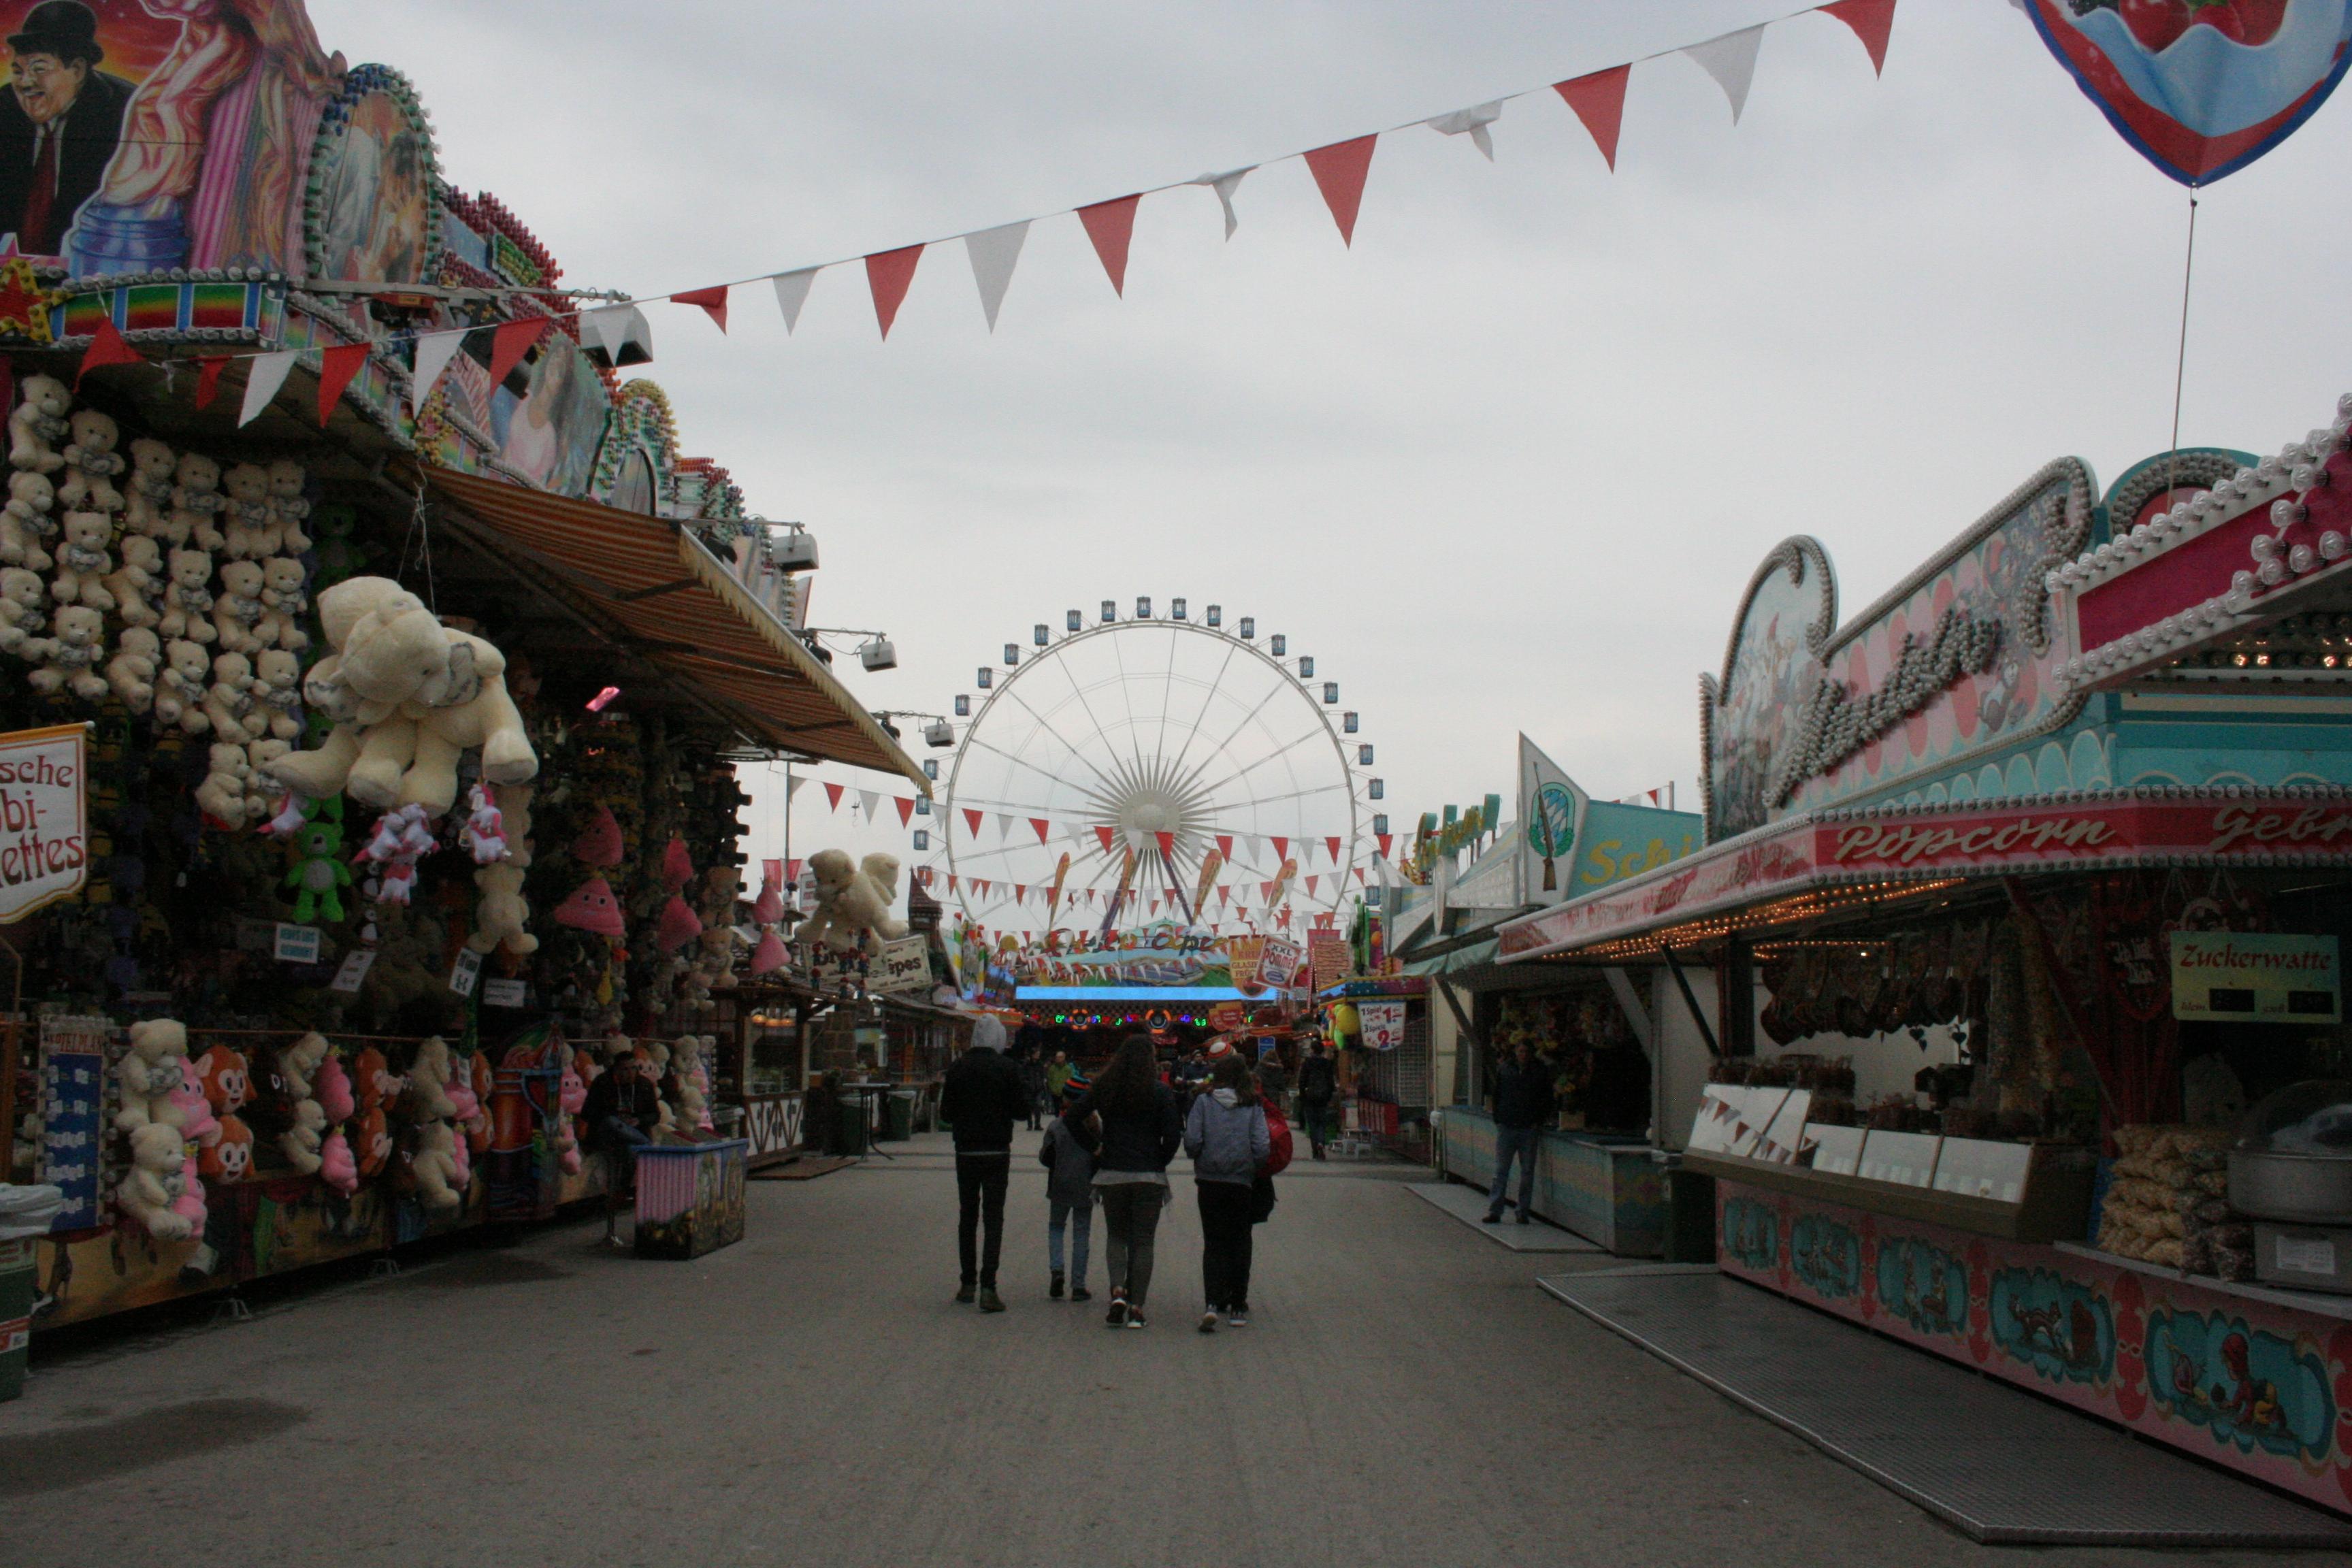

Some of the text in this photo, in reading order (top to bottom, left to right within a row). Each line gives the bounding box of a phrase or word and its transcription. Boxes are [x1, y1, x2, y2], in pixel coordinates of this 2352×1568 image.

[1835, 815, 2116, 864] Popcorn
[1273, 945, 1292, 956] XXL
[2180, 943, 2332, 970] Zuckerwatte
[1367, 1005, 1382, 1016] Spiel
